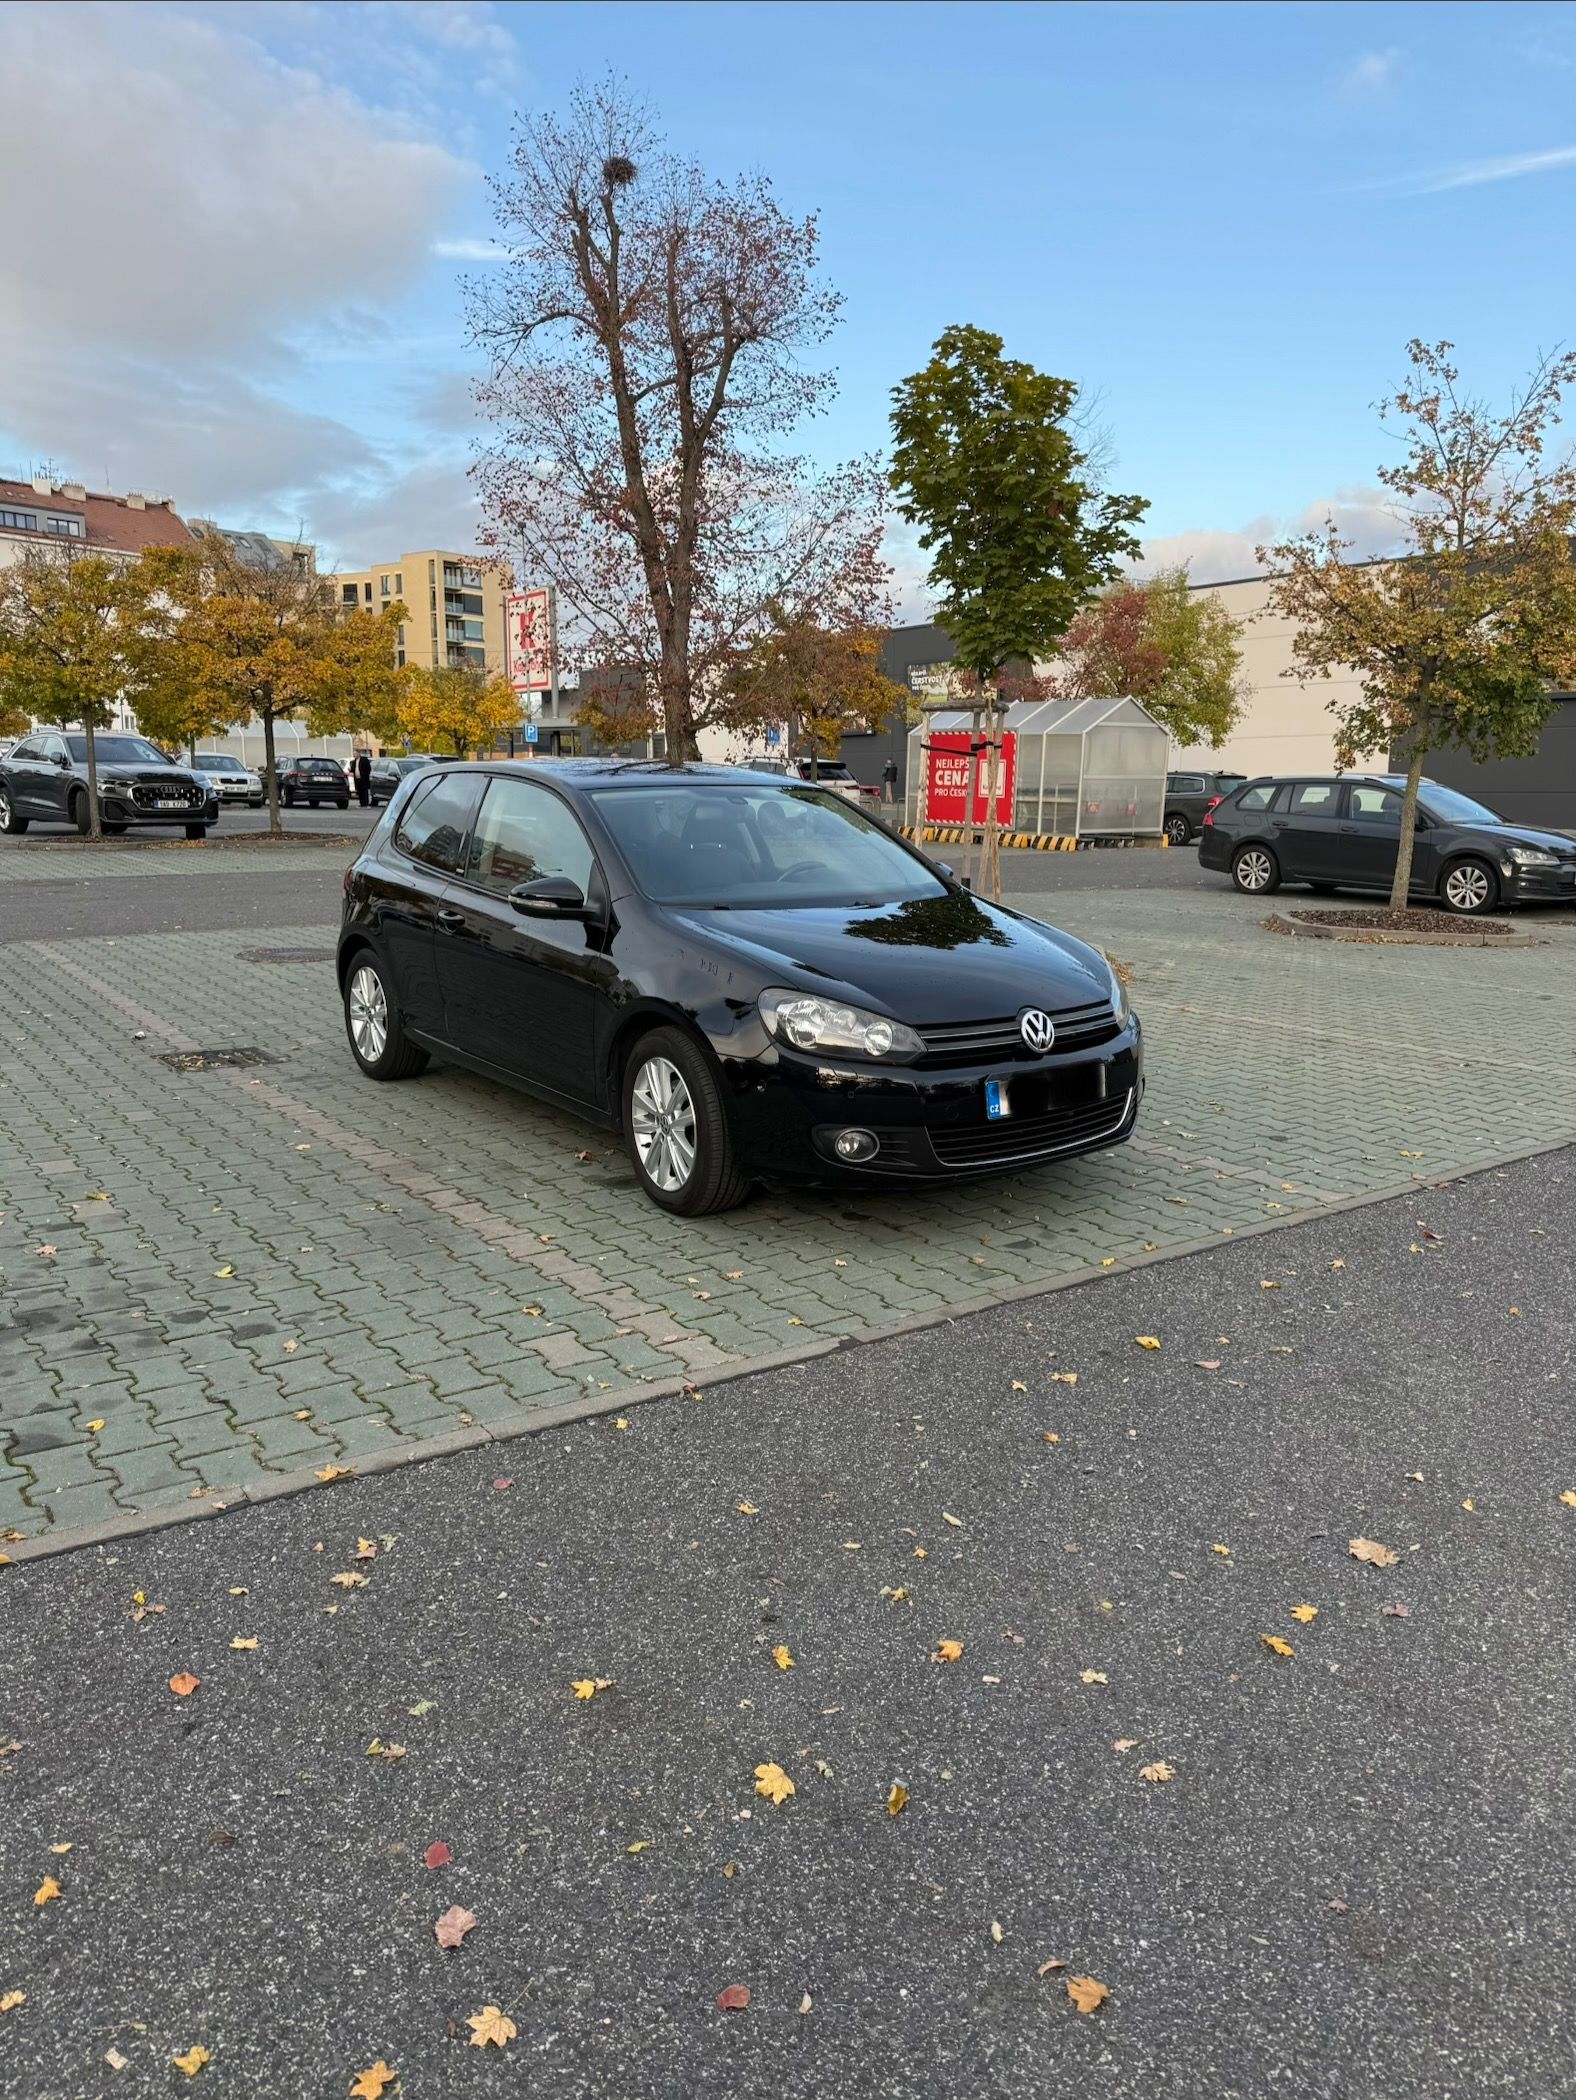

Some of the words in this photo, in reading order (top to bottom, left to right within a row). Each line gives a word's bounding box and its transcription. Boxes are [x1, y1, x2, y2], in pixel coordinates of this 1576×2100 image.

[527, 725, 535, 737] P
[935, 756, 970, 769] NEJLEPŠ
[934, 787, 949, 797] PRO
[989, 1103, 1000, 1114] CZ
